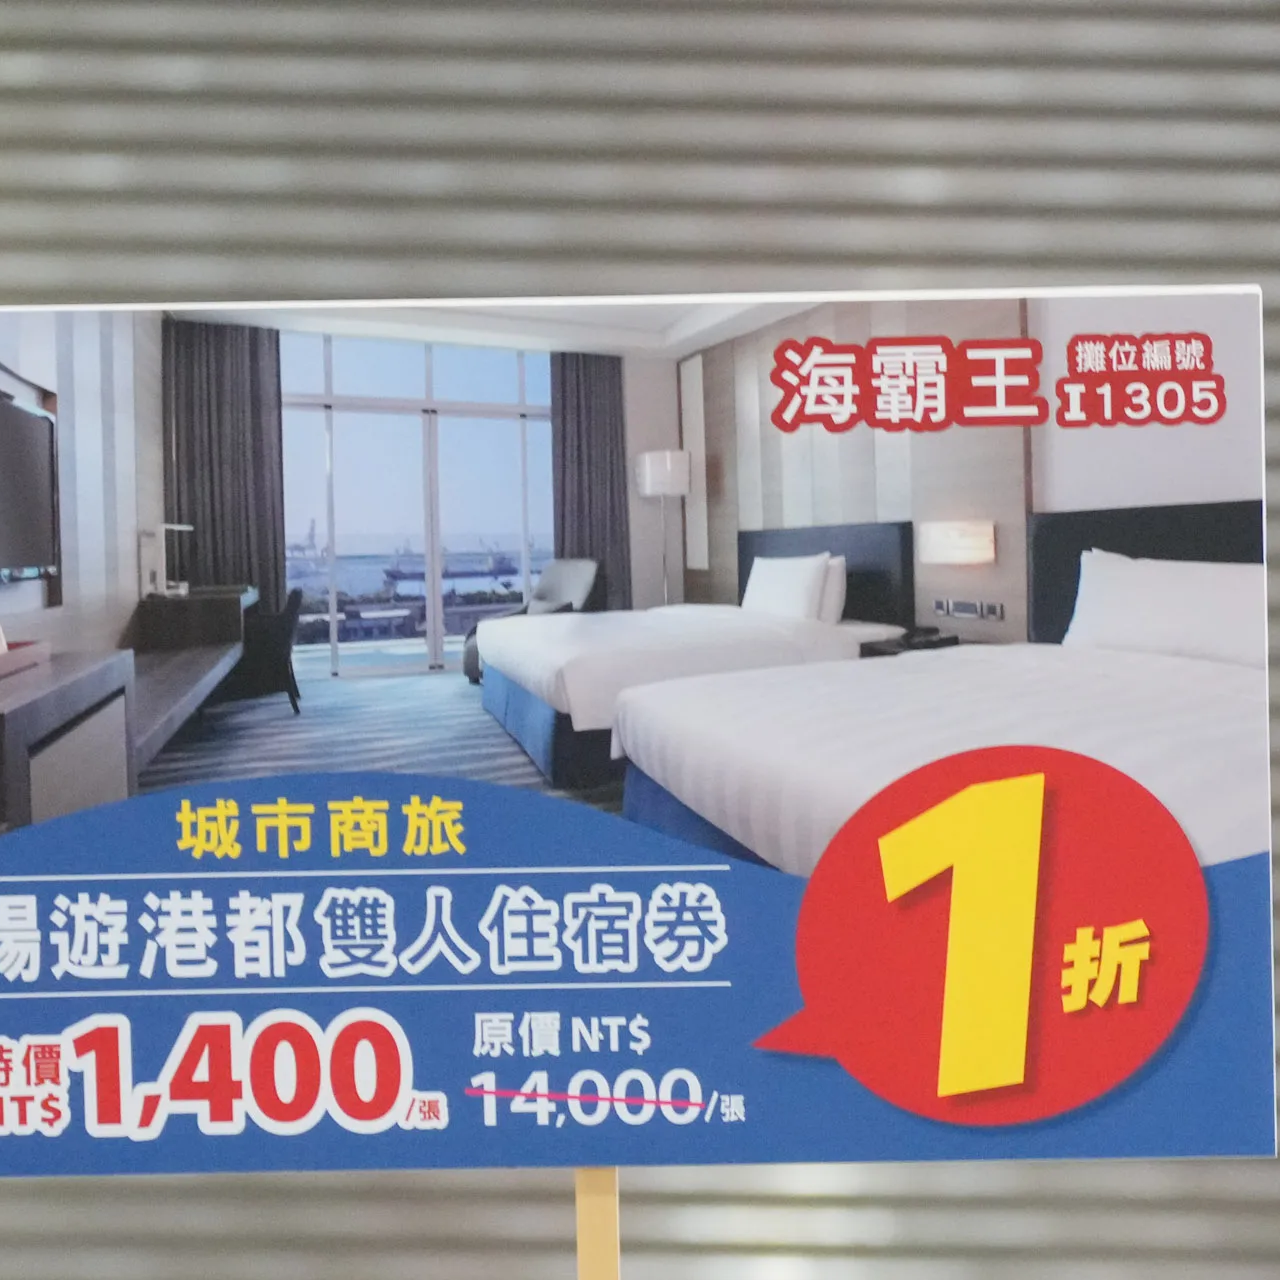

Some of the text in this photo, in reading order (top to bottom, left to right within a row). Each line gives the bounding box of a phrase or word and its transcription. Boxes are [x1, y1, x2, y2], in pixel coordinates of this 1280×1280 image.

[1075, 338, 1206, 373] 攤位編號
[781, 345, 1040, 424] 海霸王
[1063, 380, 1219, 422] I1305
[175, 795, 467, 859] 城市商旅
[472, 1011, 652, 1058] 原價 NT$
